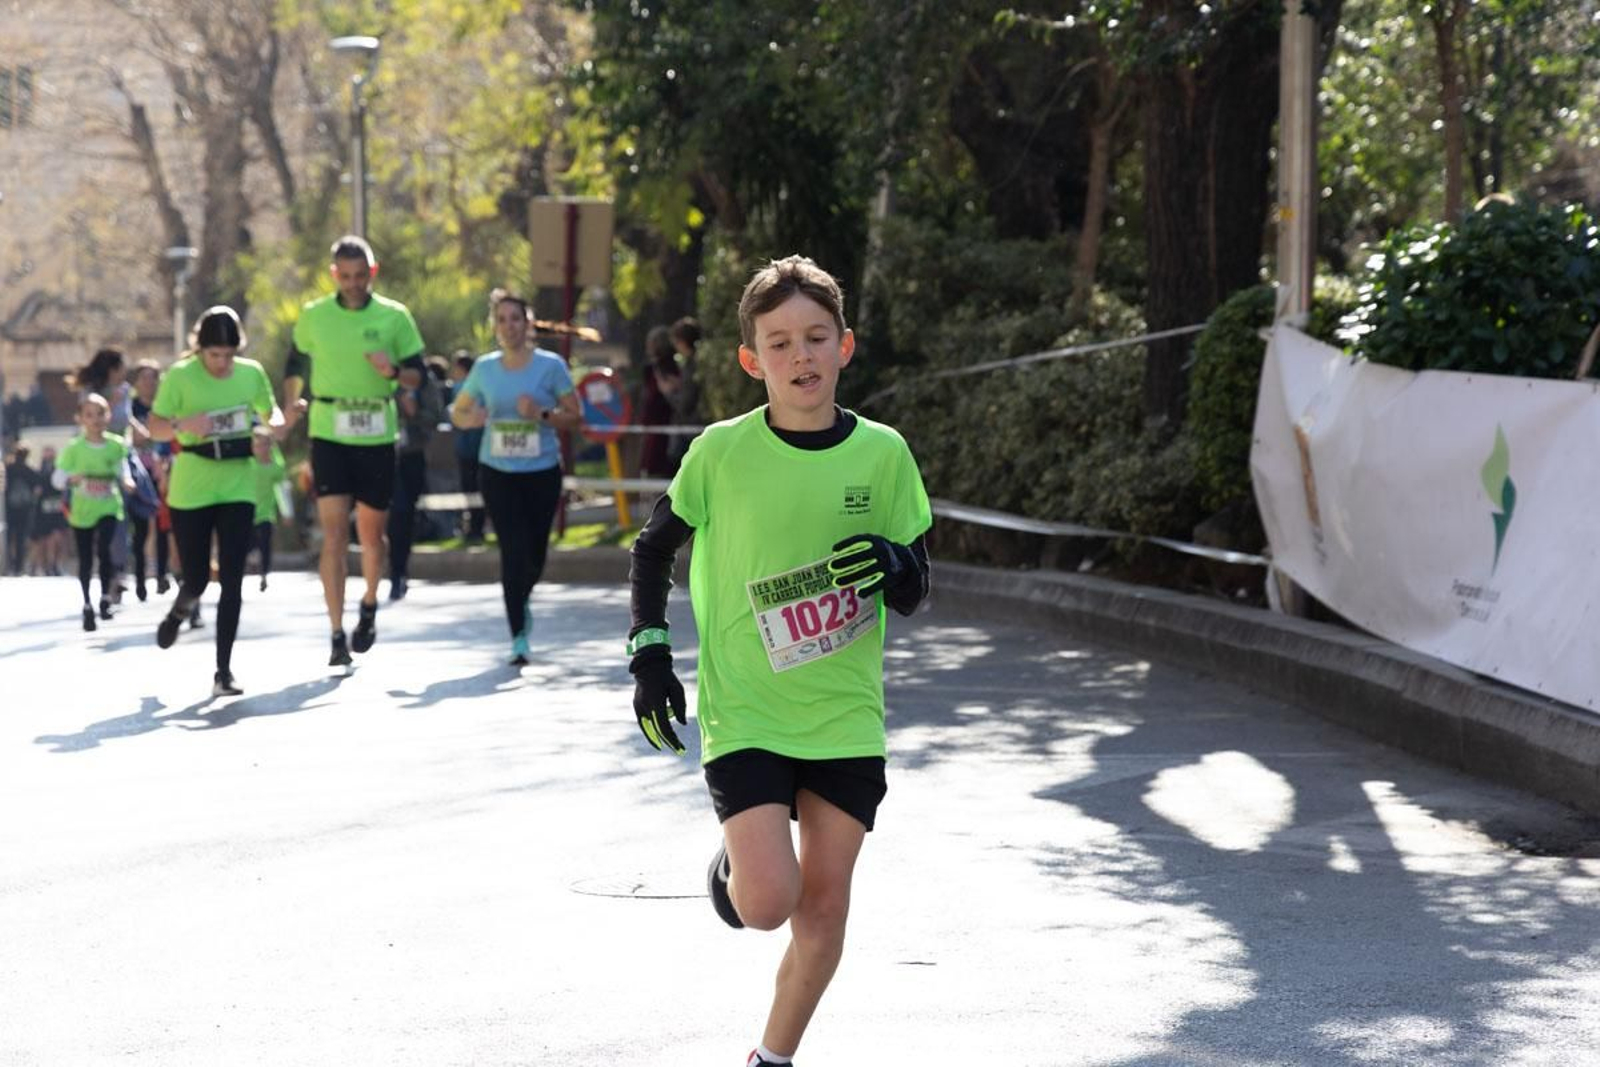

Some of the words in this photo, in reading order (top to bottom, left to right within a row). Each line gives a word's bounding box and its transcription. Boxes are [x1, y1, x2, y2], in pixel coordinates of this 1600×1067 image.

[761, 594, 771, 606] IV
[771, 585, 806, 604] CARRERA
[805, 573, 836, 596] POPULA
[773, 577, 790, 591] SAN
[792, 569, 814, 584] JUAN
[781, 585, 859, 641] 1023
